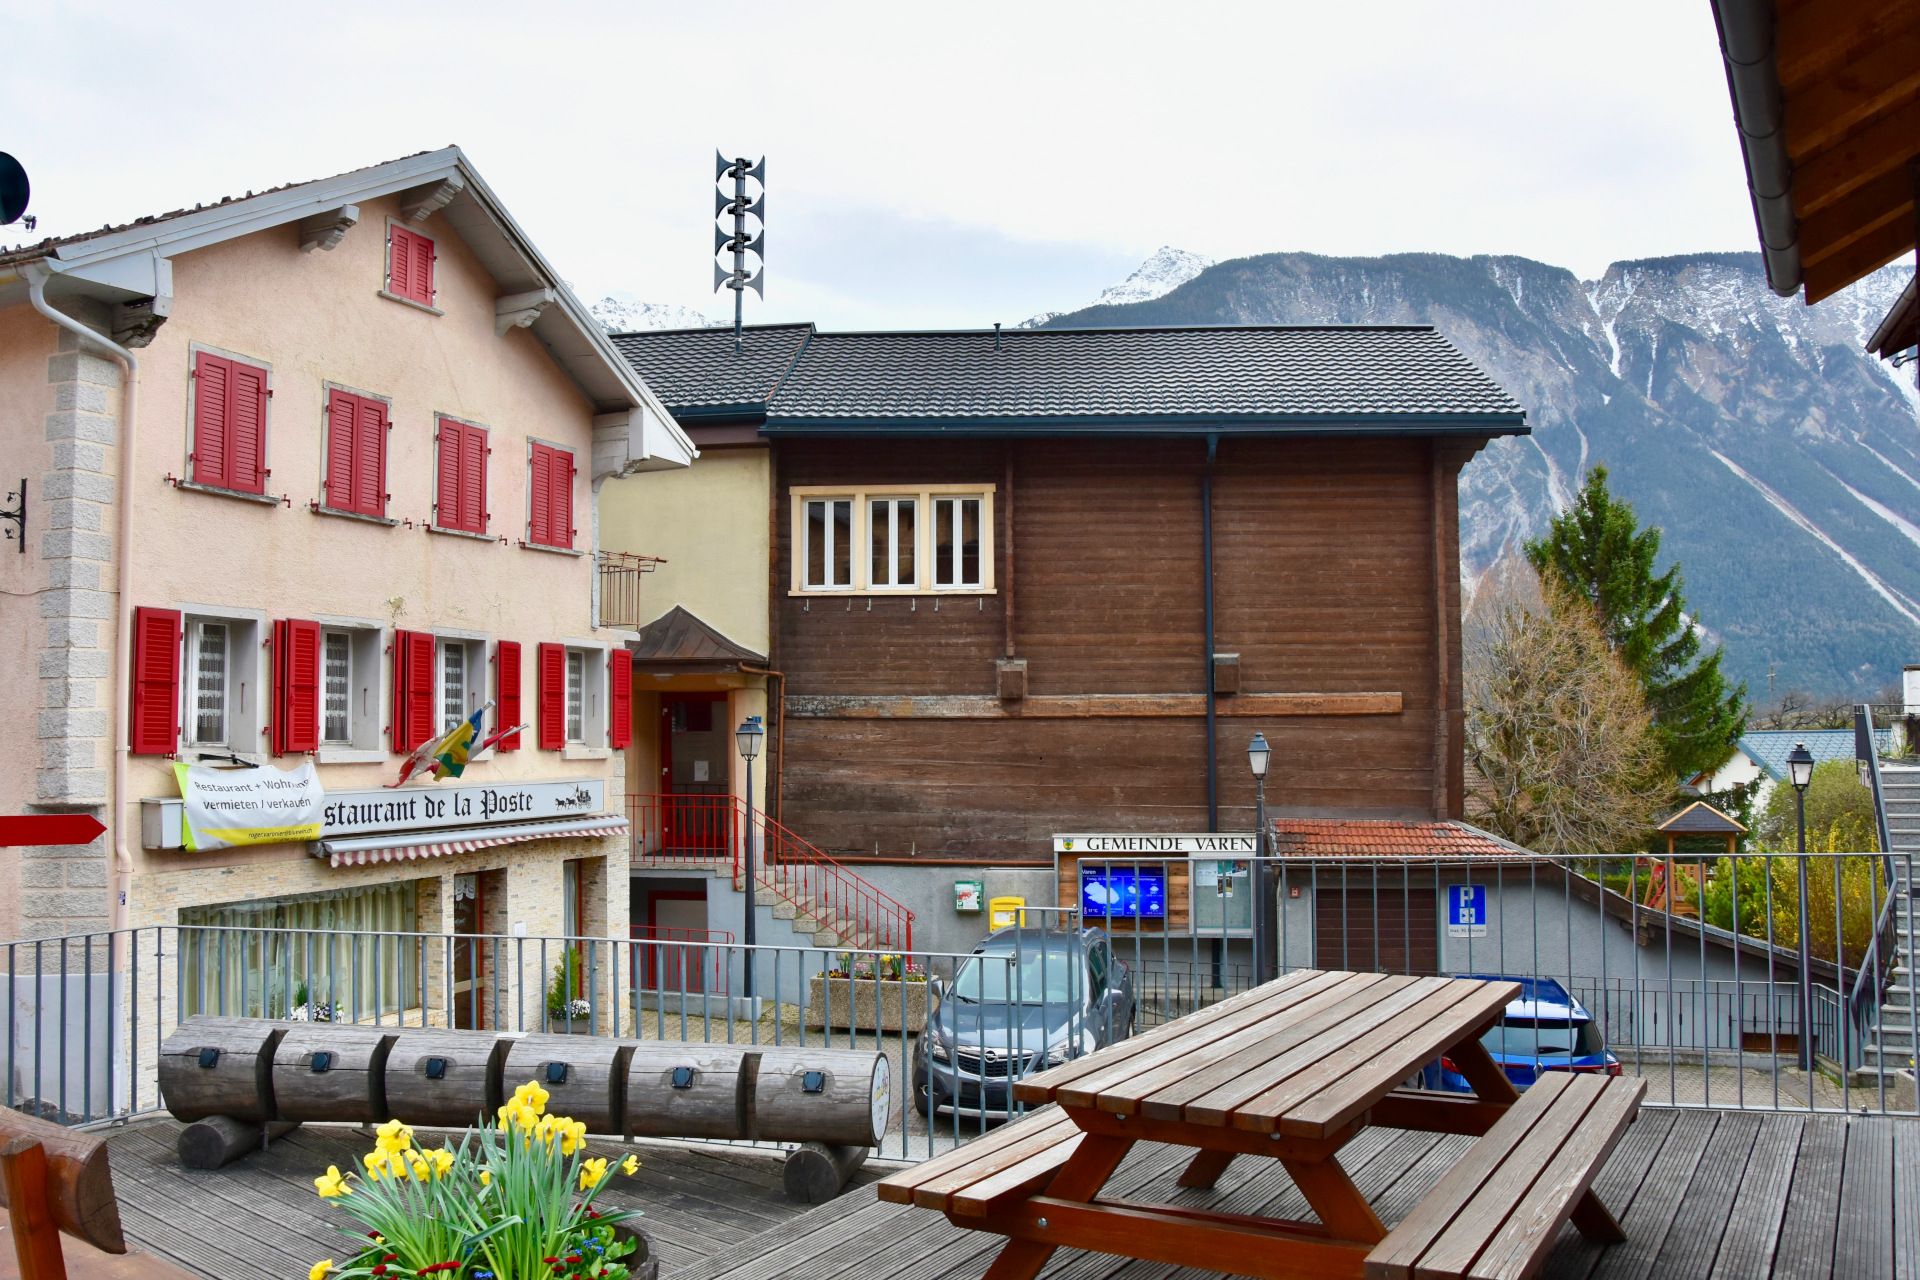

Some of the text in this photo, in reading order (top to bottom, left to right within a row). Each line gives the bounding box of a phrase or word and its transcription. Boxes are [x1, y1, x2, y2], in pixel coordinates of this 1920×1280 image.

[194, 781, 253, 793] Restaurant
[203, 799, 259, 810] vermieten
[324, 789, 533, 827] staurant de la Poste
[1086, 837, 1253, 850] GEMEINDE VAREN
[1460, 886, 1474, 907] P
